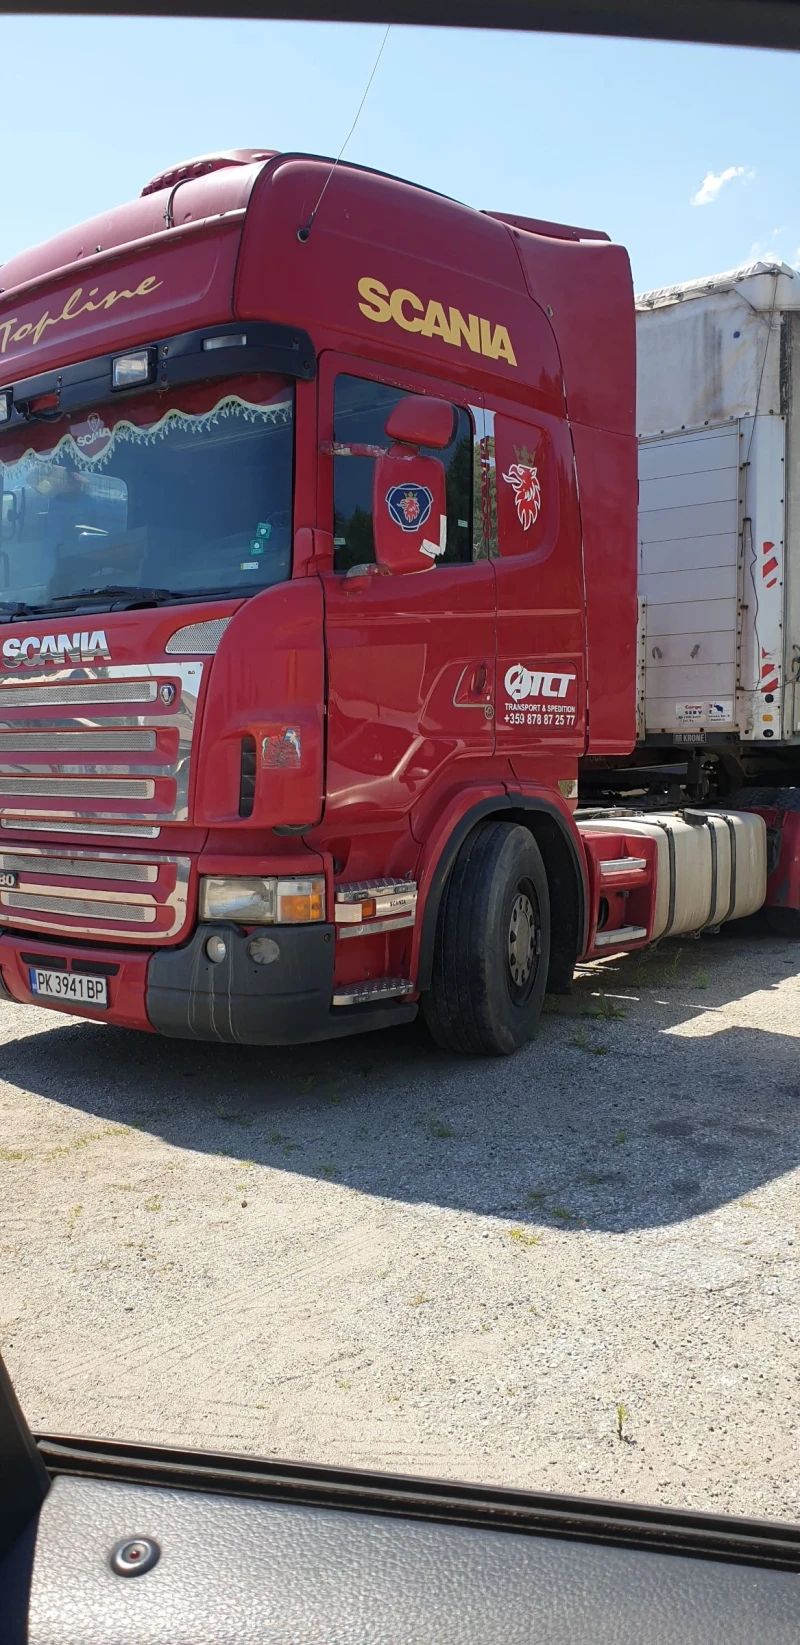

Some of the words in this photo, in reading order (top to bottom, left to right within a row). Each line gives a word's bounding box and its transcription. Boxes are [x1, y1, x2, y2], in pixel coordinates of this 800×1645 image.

[0, 275, 163, 354] Topline
[357, 276, 518, 367] SCANIA
[2, 630, 111, 668] SCANIA
[504, 703, 541, 712] TRANSPORT
[541, 704, 546, 712] &
[547, 704, 576, 713] SPEDITION
[504, 712, 525, 725] +359
[527, 713, 542, 725] 878
[543, 714, 553, 725] 87
[555, 714, 565, 726] 25
[566, 715, 576, 726] 77
[683, 734, 705, 742] KRONE
[38, 972, 53, 994] PK
[55, 975, 84, 998] 3941
[87, 979, 104, 1000] BP
